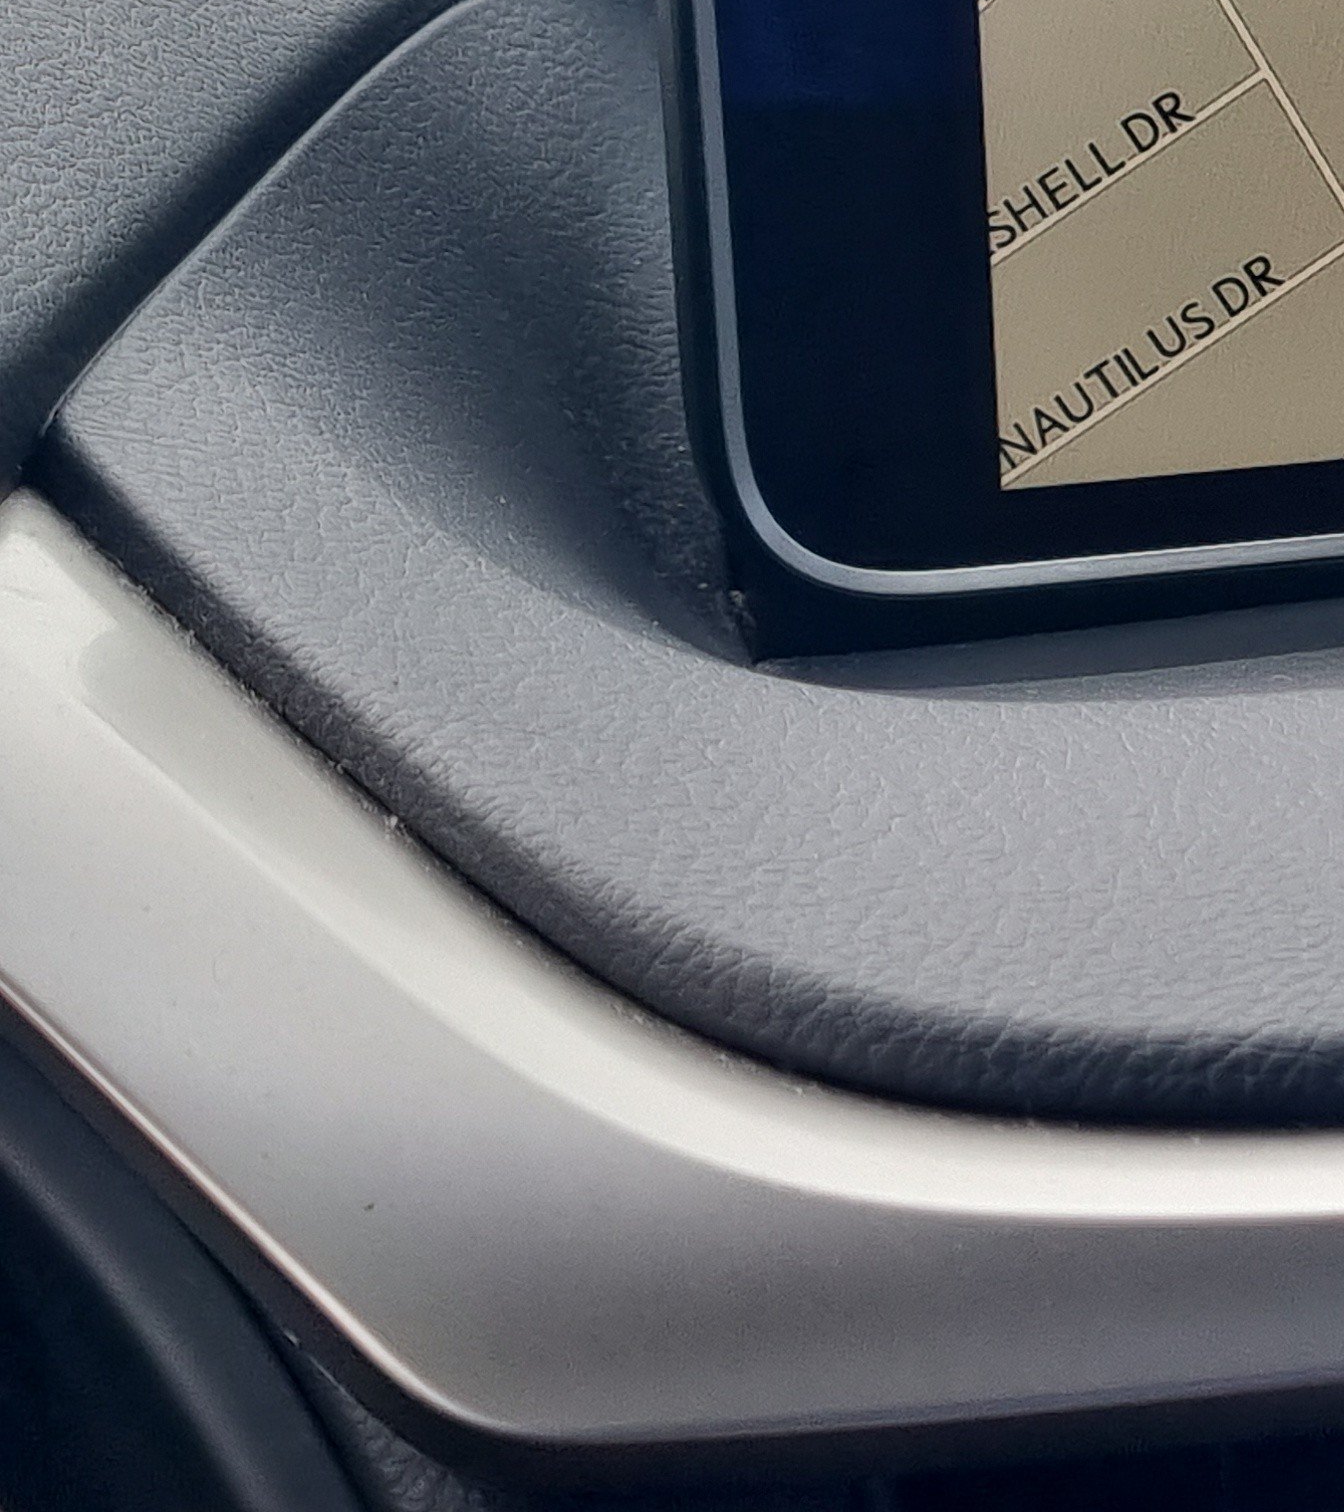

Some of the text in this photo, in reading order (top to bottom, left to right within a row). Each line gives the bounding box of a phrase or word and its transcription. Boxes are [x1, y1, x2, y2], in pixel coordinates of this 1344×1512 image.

[987, 90, 1196, 249] SHELL DR
[998, 254, 1285, 470] NAUTILUS DR
